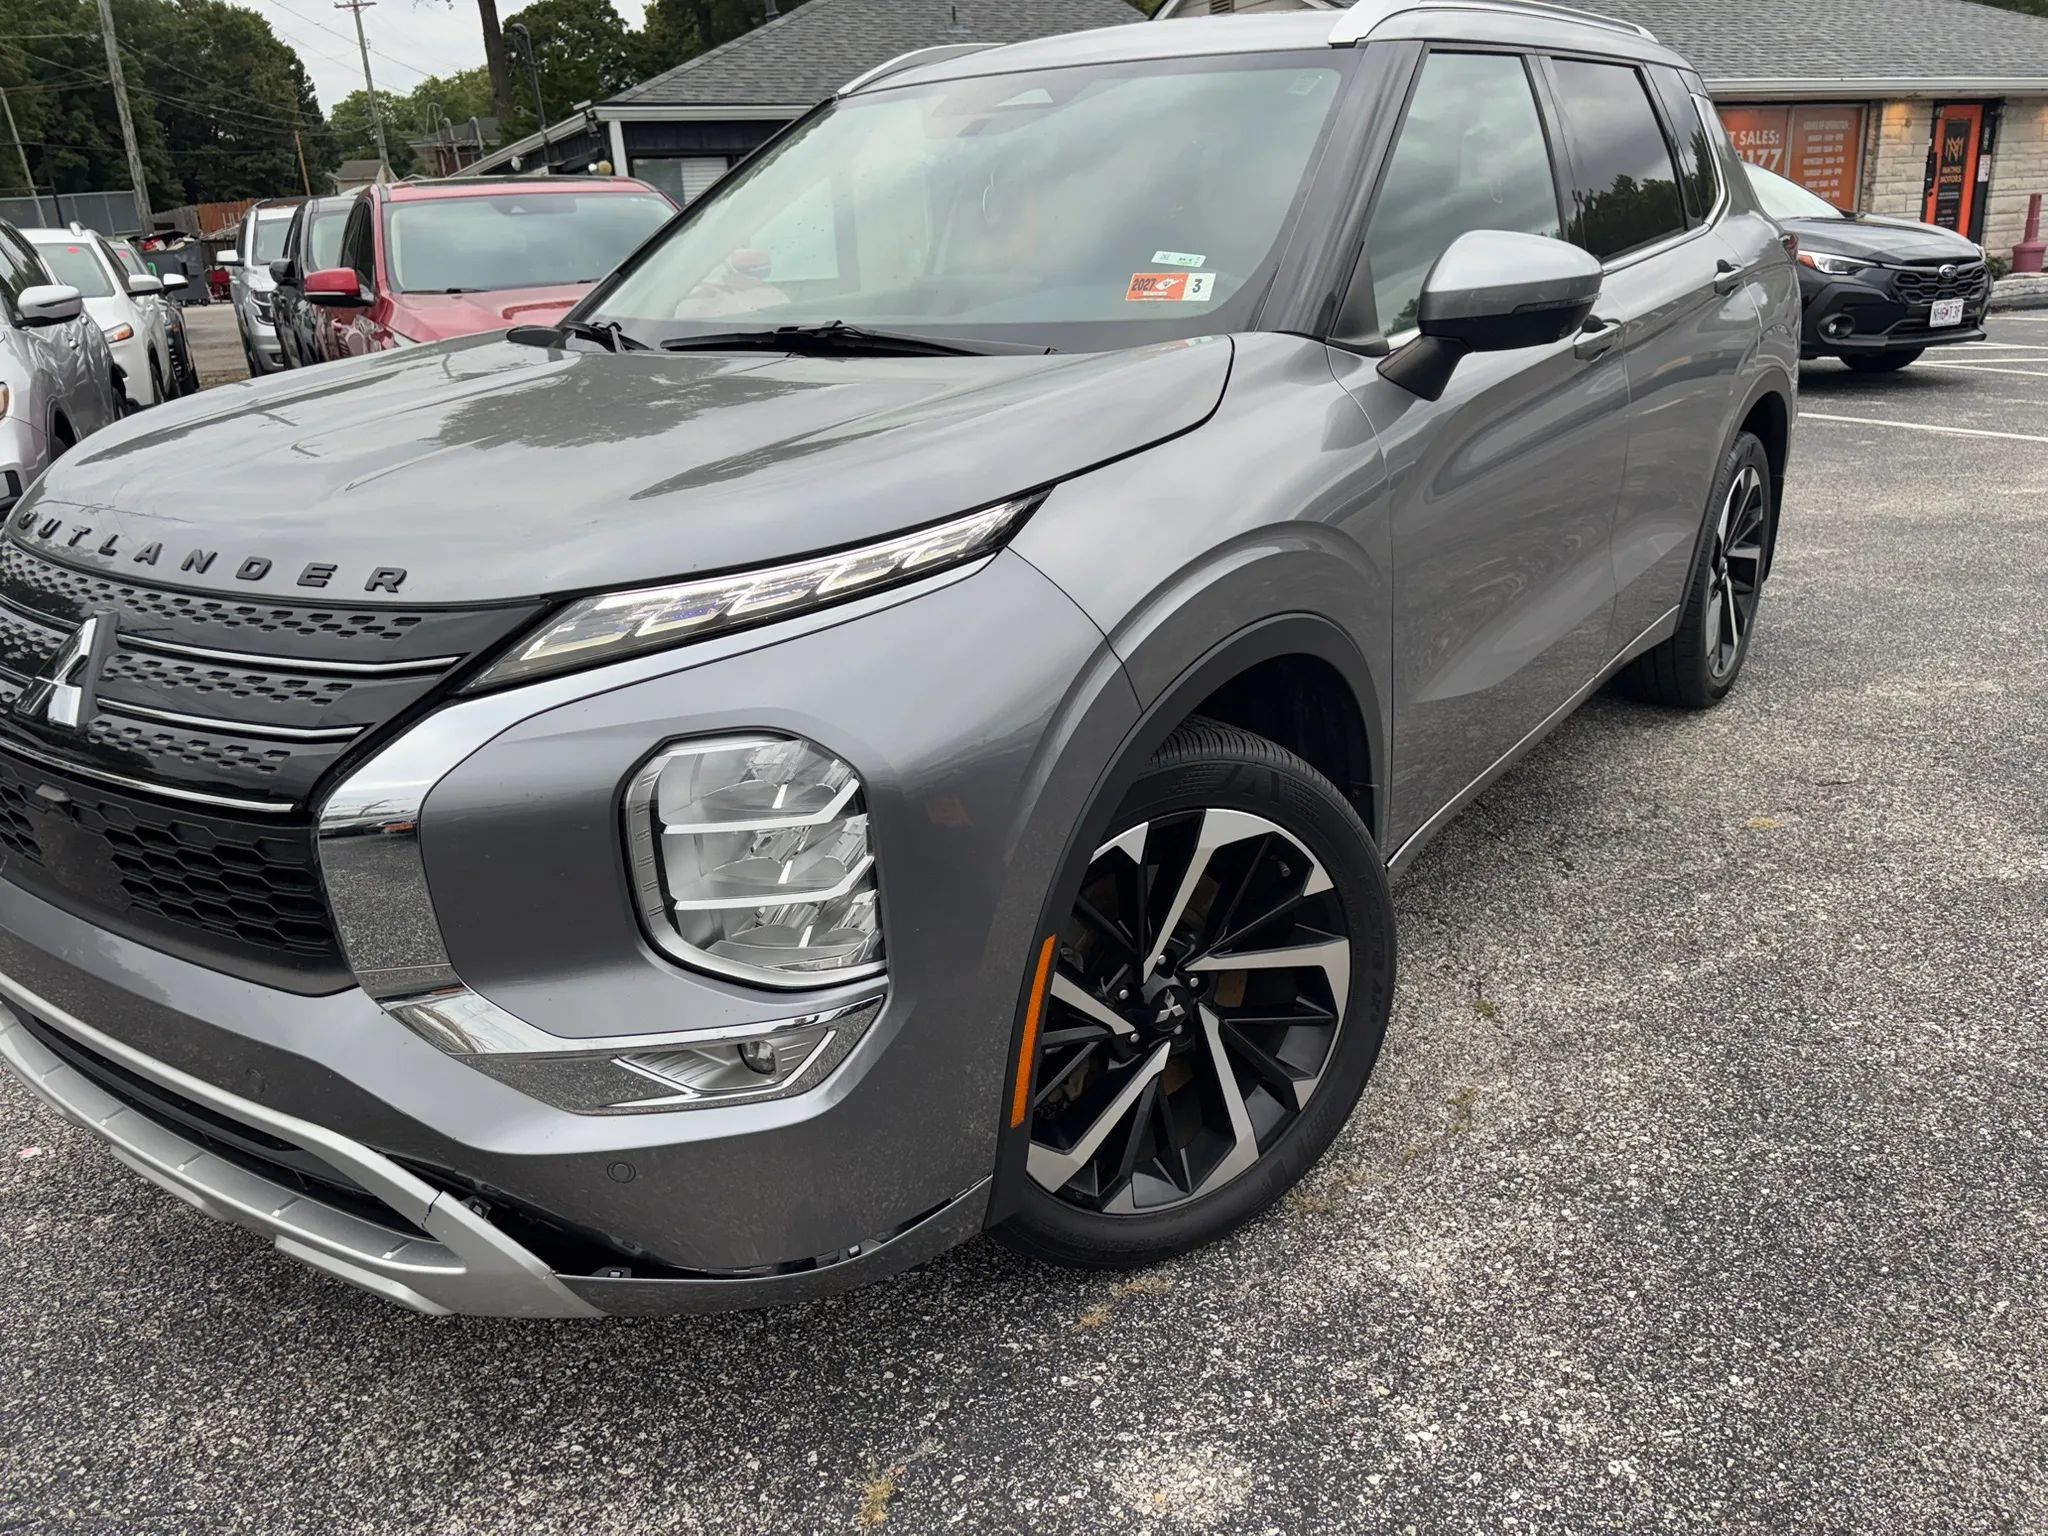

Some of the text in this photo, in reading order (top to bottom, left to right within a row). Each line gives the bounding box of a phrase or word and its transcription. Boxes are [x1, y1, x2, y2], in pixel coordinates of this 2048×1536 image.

[1739, 130, 1780, 146] SALES:
[1736, 148, 1784, 171] 177
[1131, 278, 1203, 293] 2027 3
[16, 509, 408, 593] OUTLANDER
